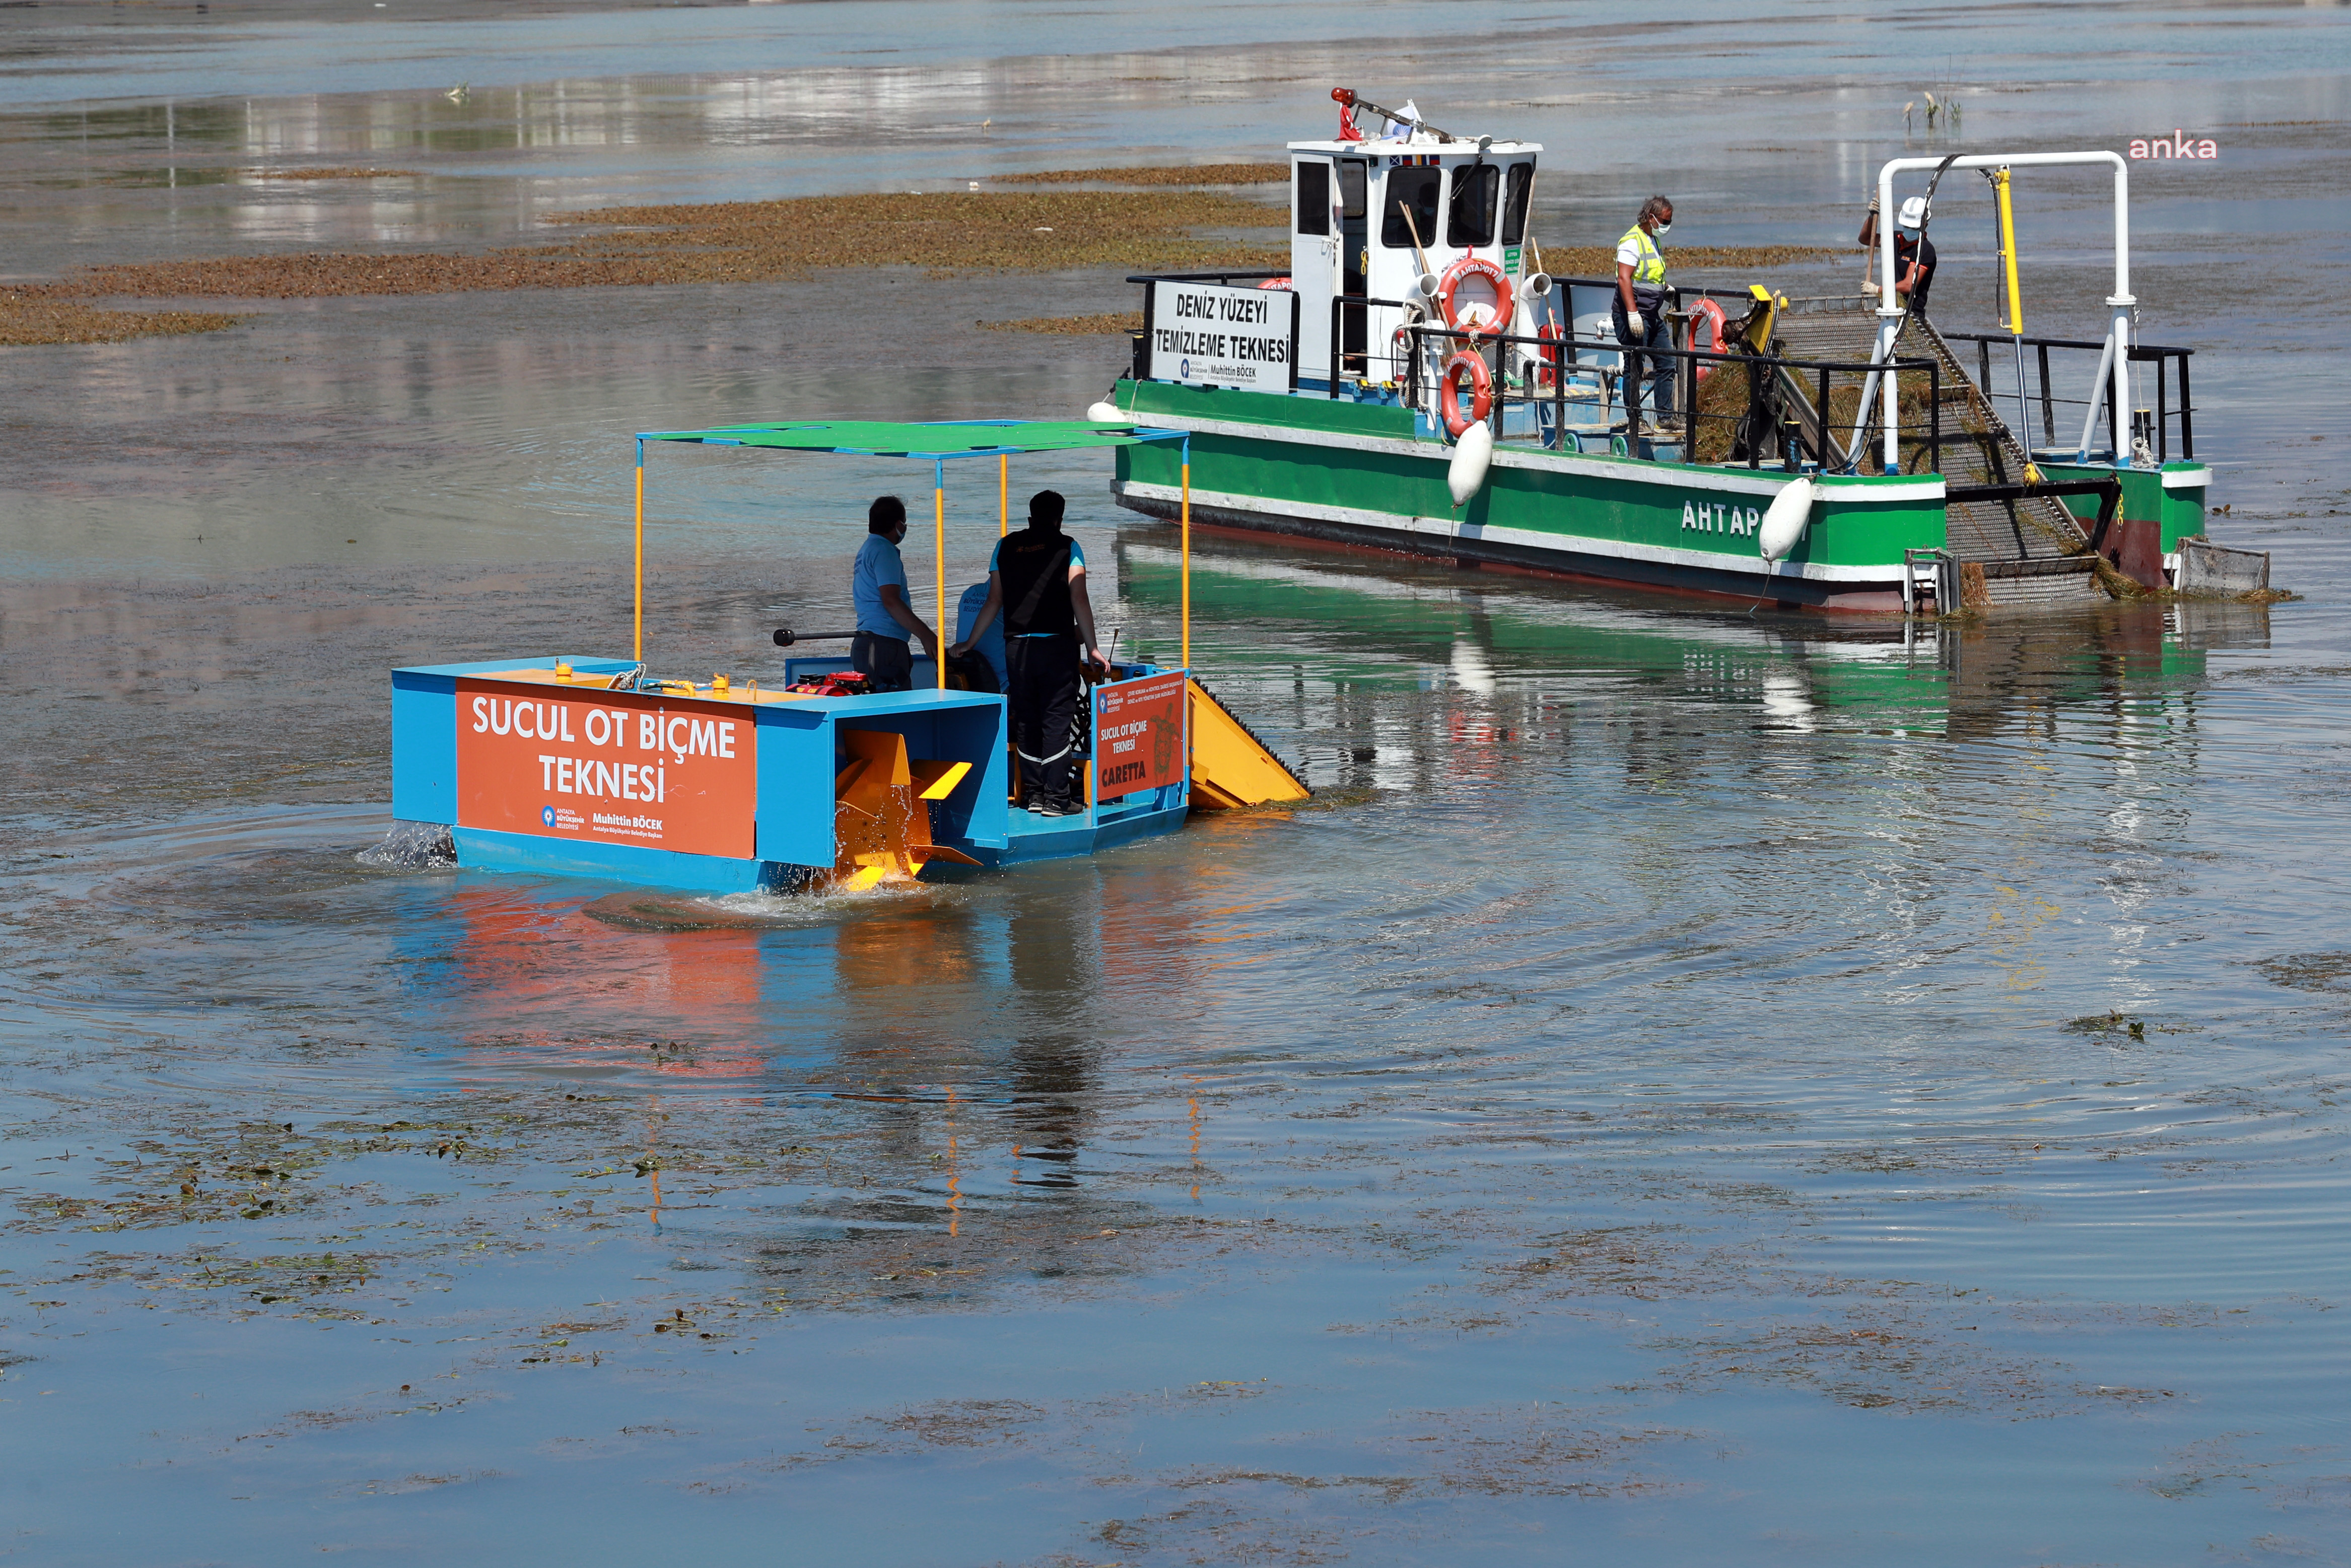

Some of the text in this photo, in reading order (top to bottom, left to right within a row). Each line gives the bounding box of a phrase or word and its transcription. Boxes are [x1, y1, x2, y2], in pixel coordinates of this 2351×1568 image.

[1177, 290, 1267, 324] DENİZ YÜZEYİ
[1156, 325, 1289, 363] TEMİZLEME TEKNESİ
[1211, 364, 1256, 377] Muhittin BÖCEK
[472, 696, 735, 765] SUCUL OT BİÇME
[1101, 719, 1147, 741] SUCUL OT BİÇME
[1113, 736, 1135, 754] TEKNESİ
[538, 754, 664, 803] TEKNESİ
[1101, 761, 1146, 788] CARETTA
[557, 814, 585, 824] BÜYÜKŞEHİR
[593, 812, 663, 830] Muhittin BÖCEK
[609, 827, 631, 835] Büyükşehir
[631, 830, 648, 838] Belediye
